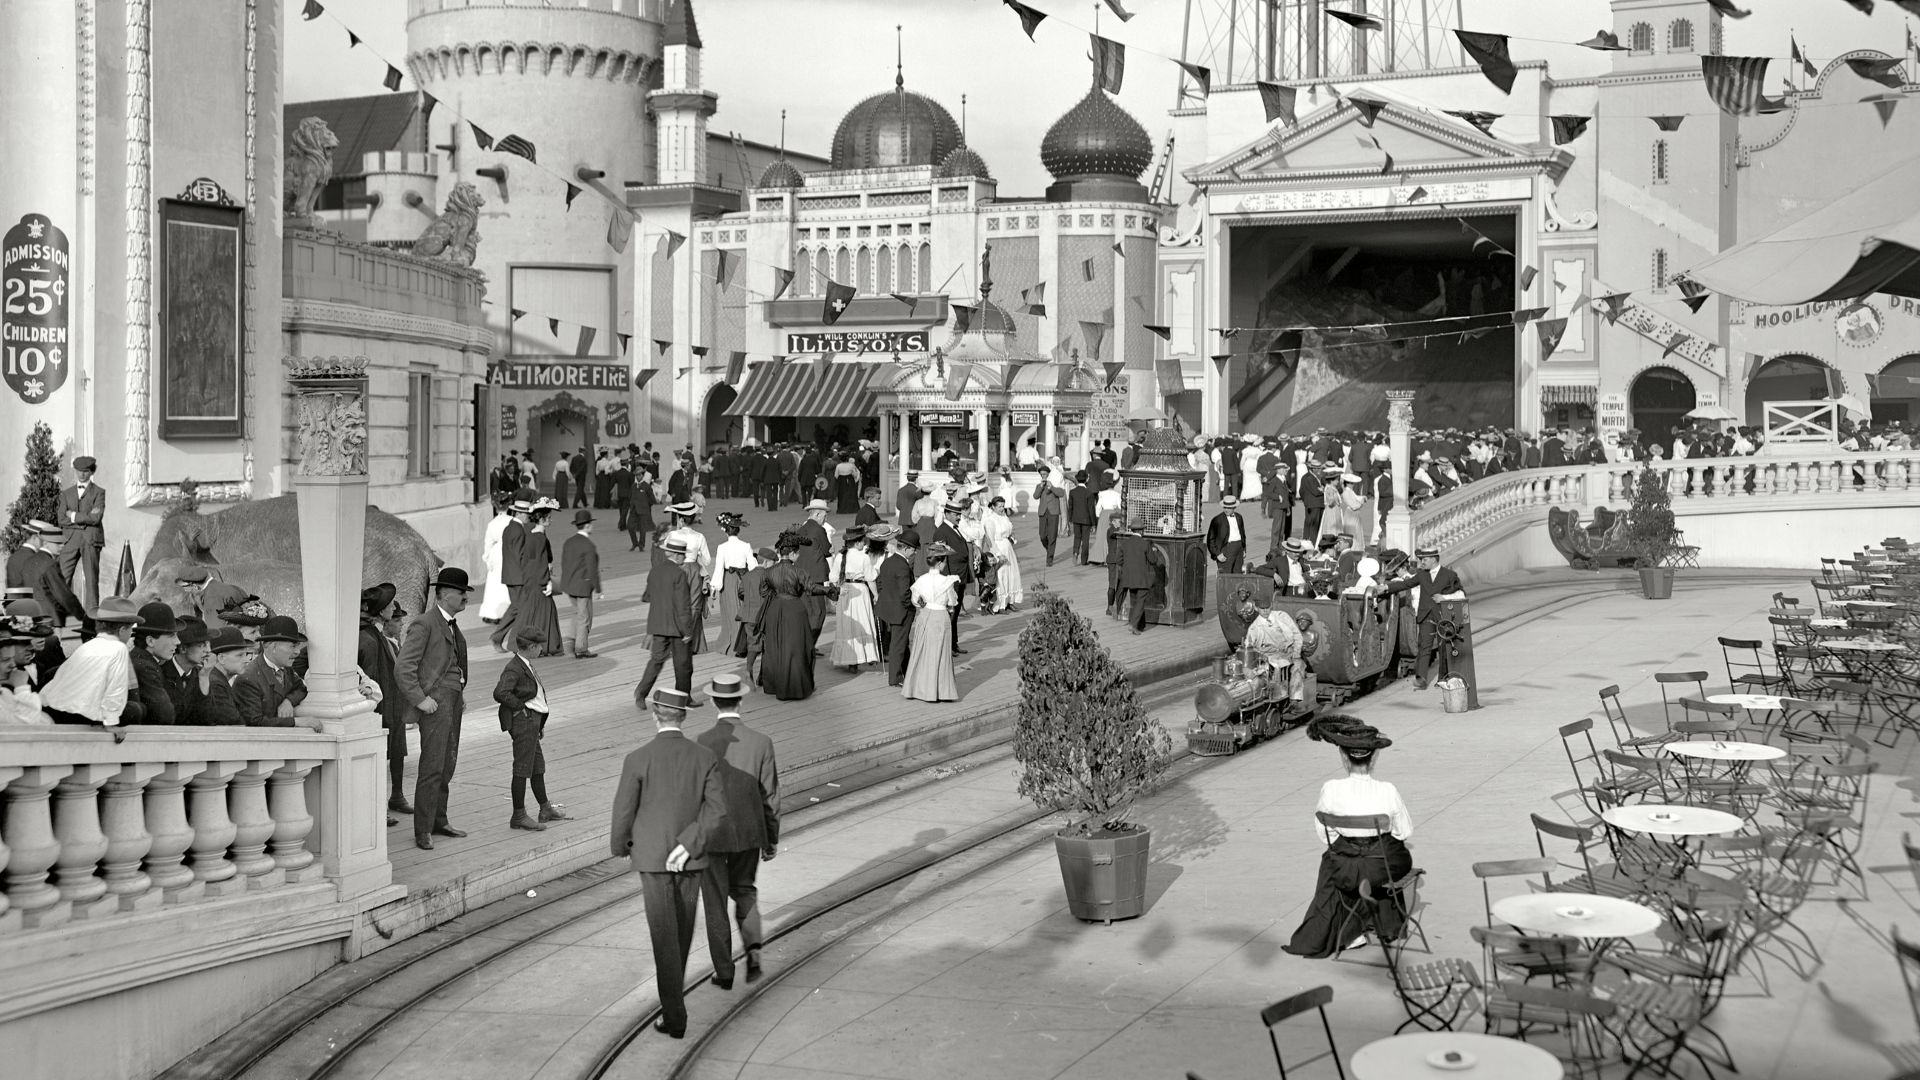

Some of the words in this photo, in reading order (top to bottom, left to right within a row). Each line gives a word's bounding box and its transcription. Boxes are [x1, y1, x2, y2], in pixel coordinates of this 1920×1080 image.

[1245, 190, 1373, 211] GENERAL
[4, 243, 68, 272] ADMISSION
[5, 275, 66, 315] 25¢
[3, 322, 67, 344] CHILDREN
[824, 332, 843, 340] WILL
[847, 331, 887, 340] CONKLIN'S
[6, 345, 62, 376] 10¢
[487, 364, 589, 386] ALTIMORE
[592, 366, 627, 387] FIRE
[1602, 402, 1625, 411] TEMPLE
[1601, 416, 1625, 426] MIRTH
